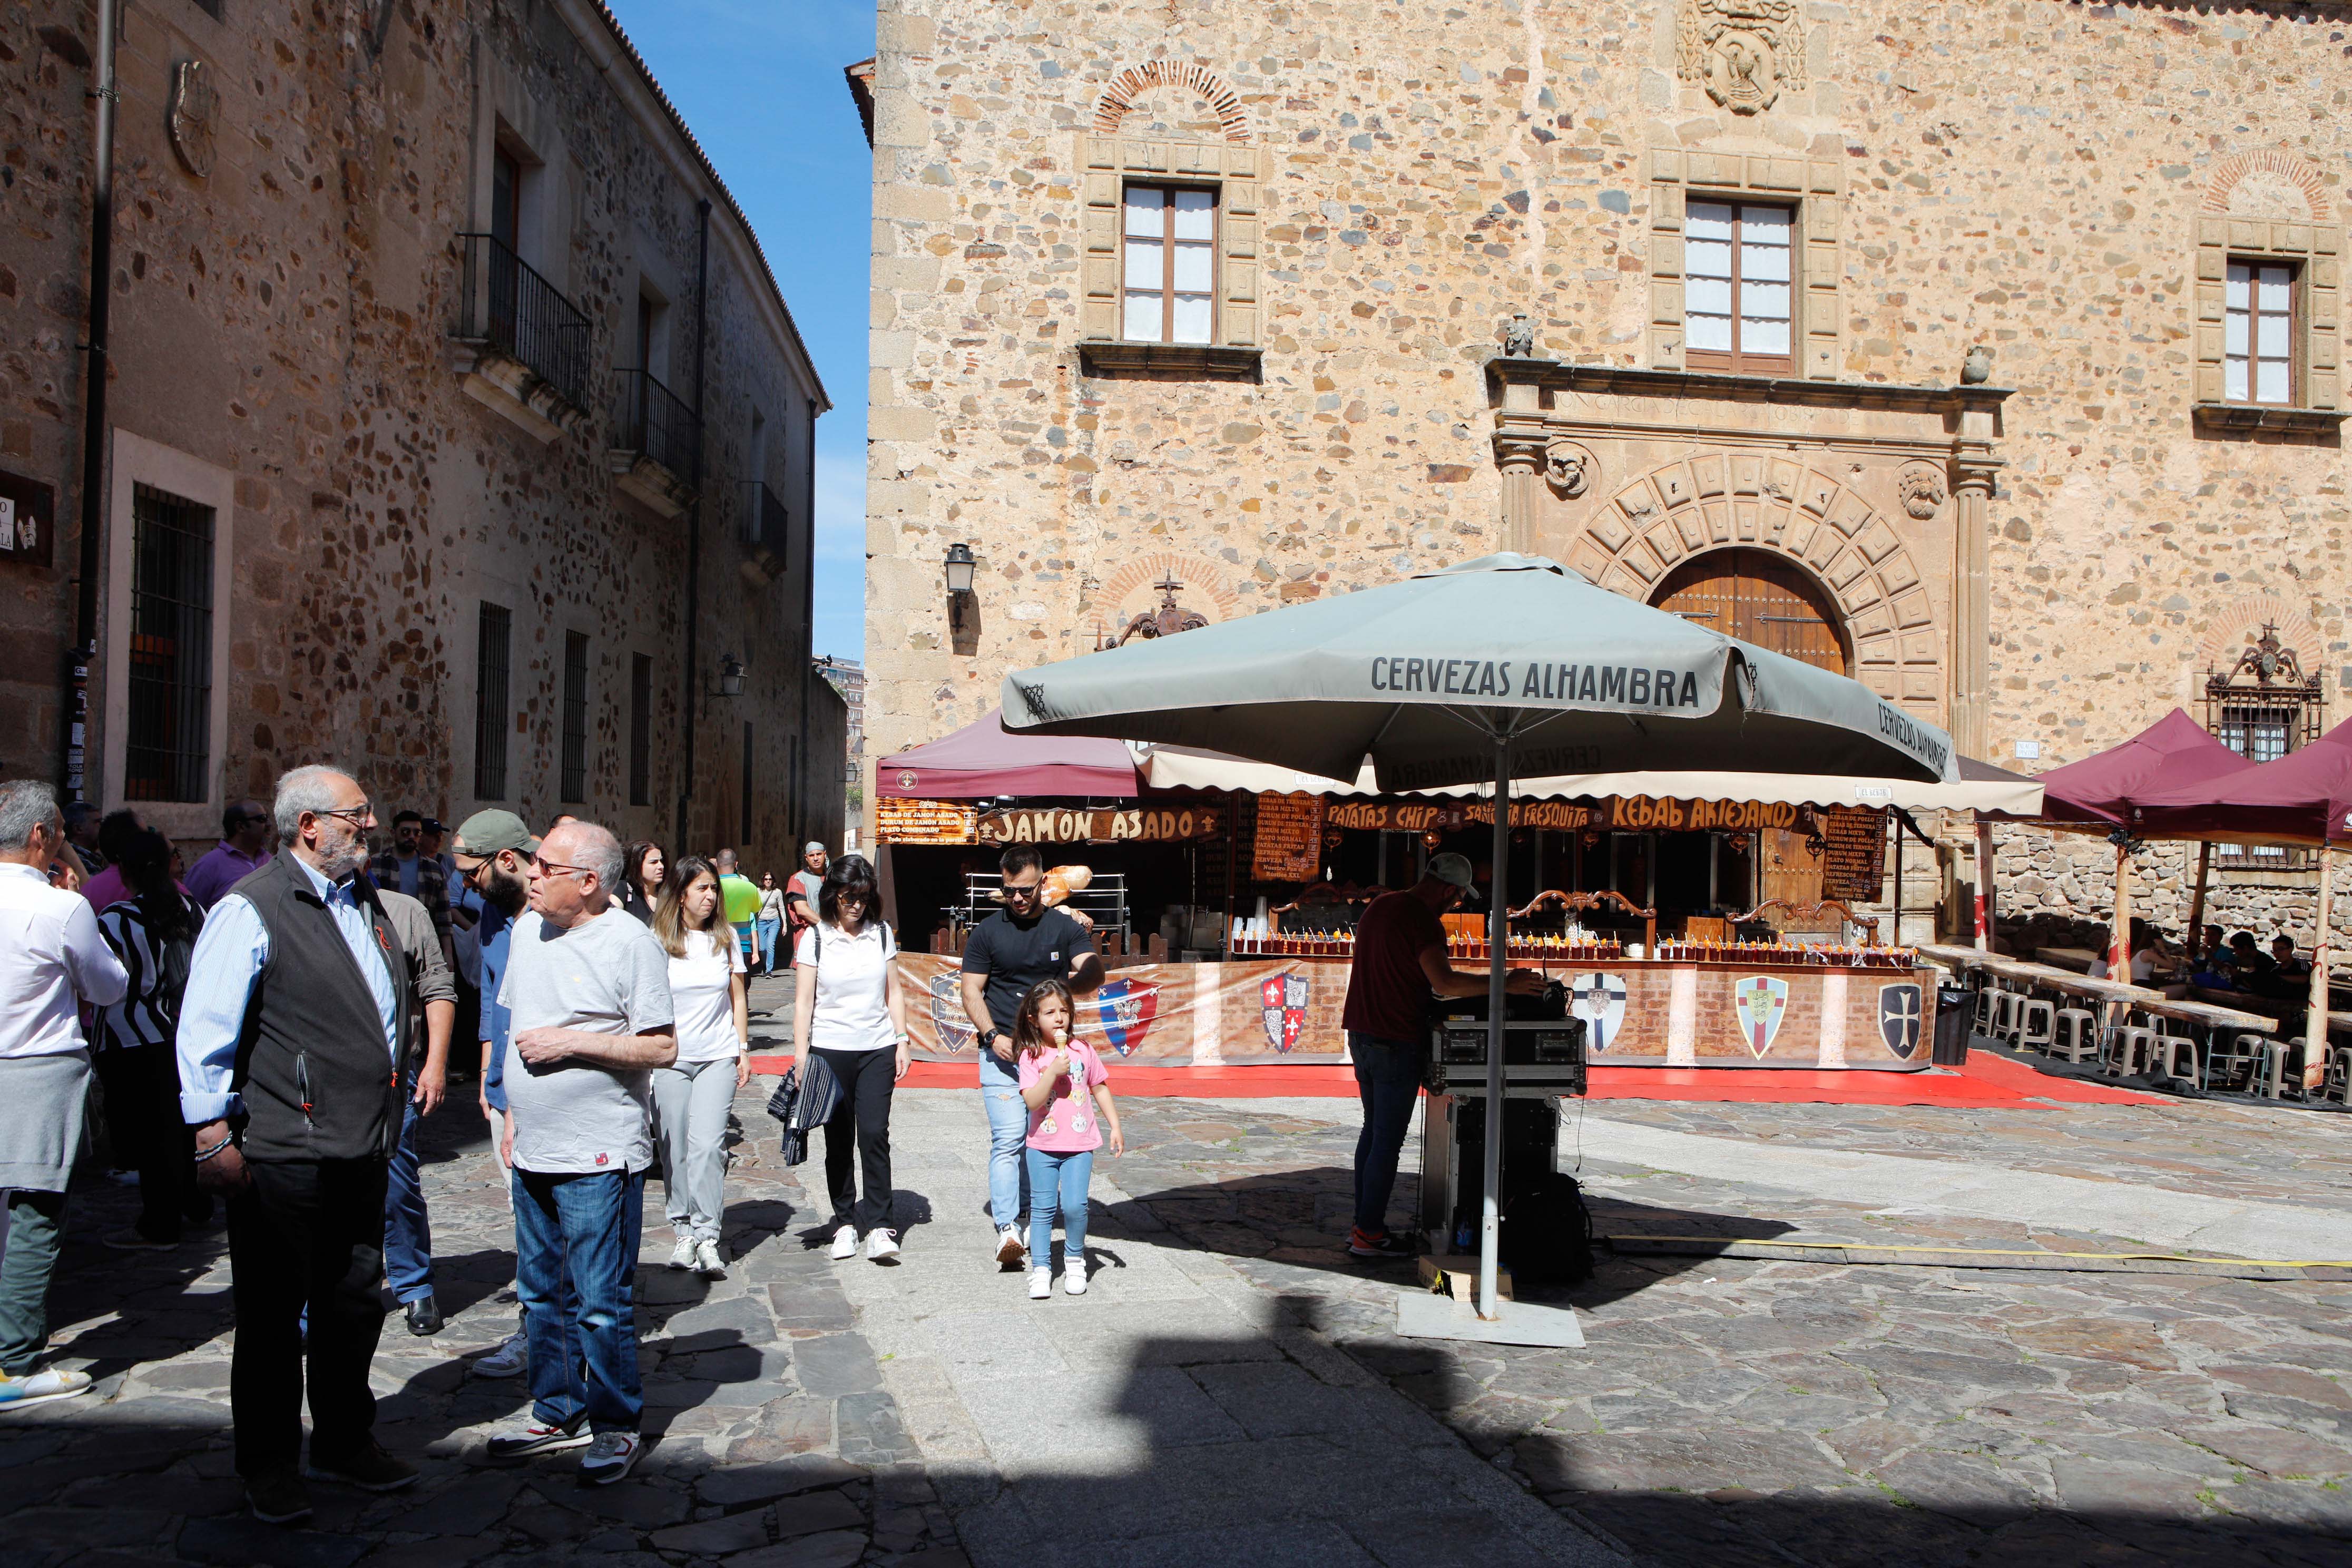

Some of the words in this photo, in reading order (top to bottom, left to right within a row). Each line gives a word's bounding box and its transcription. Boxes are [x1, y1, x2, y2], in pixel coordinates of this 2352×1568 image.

[1372, 656, 1511, 697] CERVEZAS
[1522, 662, 1699, 707] ALHAMBRA
[1878, 702, 1916, 751] CERVEZAS
[1111, 808, 1193, 840] ASADO
[1328, 802, 1388, 827] PATATAS
